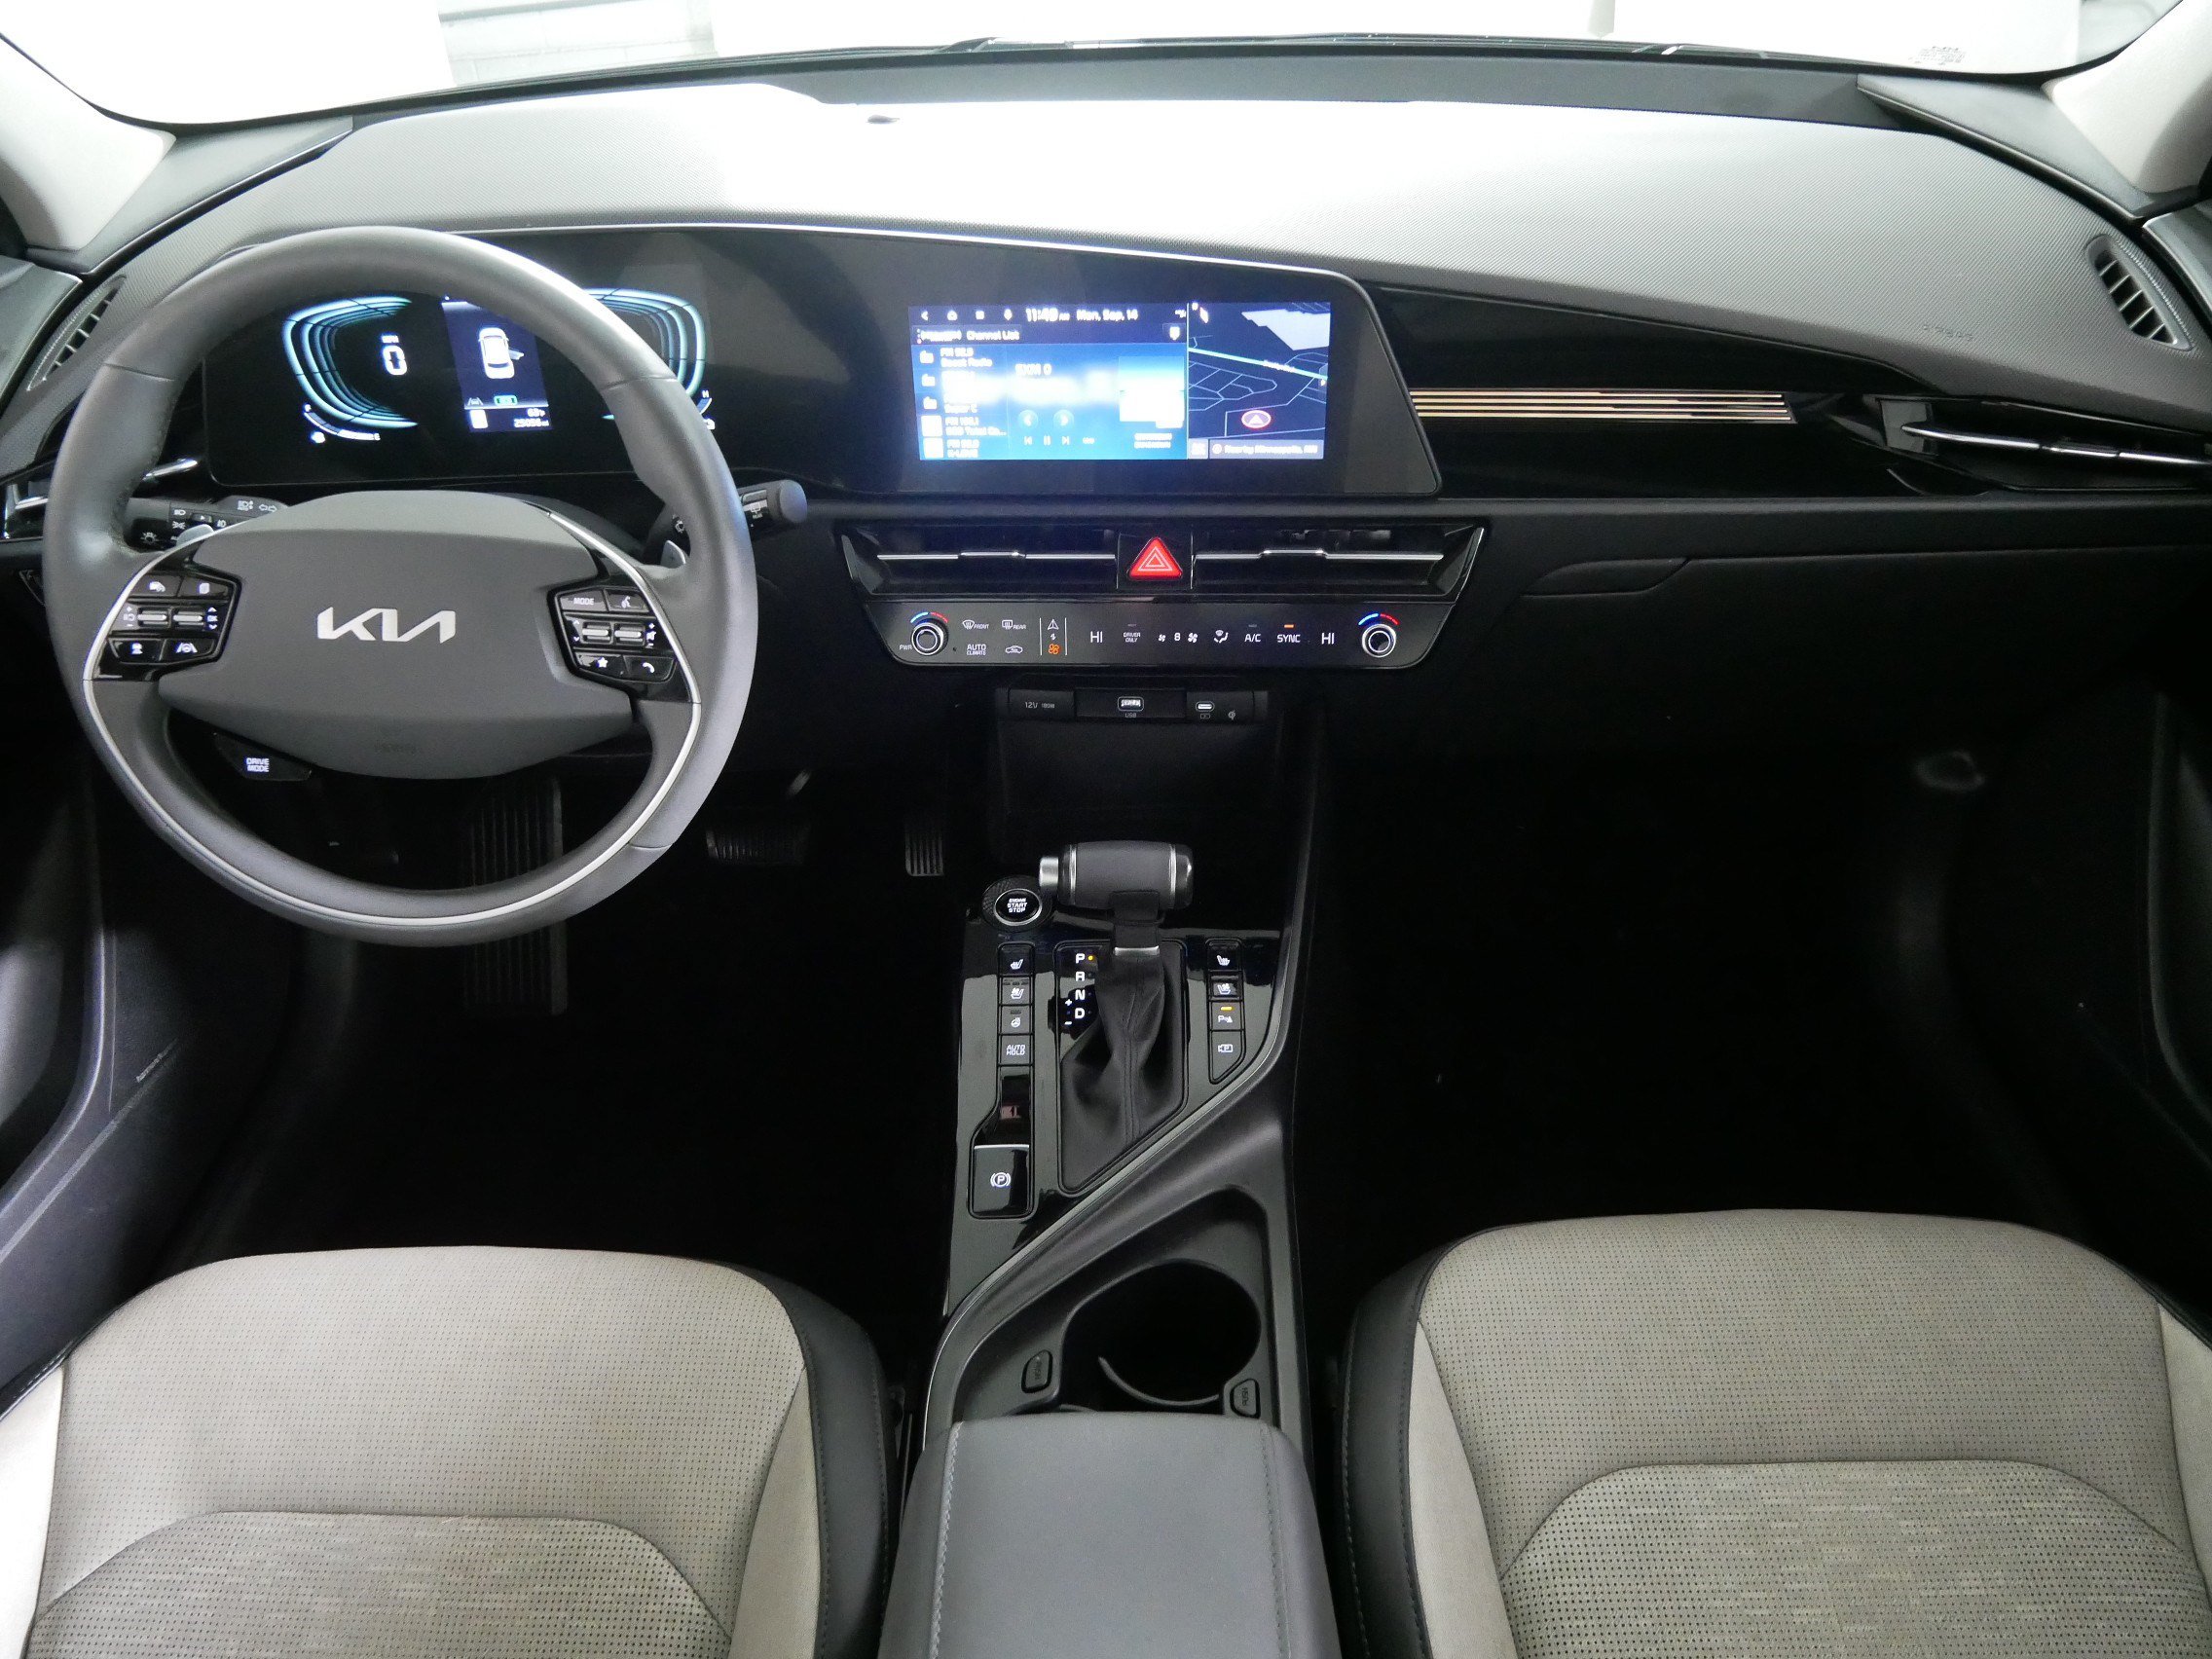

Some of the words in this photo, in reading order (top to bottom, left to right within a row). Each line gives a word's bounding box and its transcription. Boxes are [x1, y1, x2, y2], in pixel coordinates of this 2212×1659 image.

[383, 345, 408, 376] 0
[573, 597, 594, 606] MODE
[317, 607, 456, 644] KIA
[1089, 631, 1103, 644] HI
[1244, 634, 1262, 643] A/C
[1276, 634, 1301, 644] SYNC
[1321, 632, 1335, 645] HI
[1075, 953, 1086, 964] P
[1075, 971, 1086, 982] R
[1075, 989, 1086, 1001] N
[1074, 1007, 1086, 1019] D
